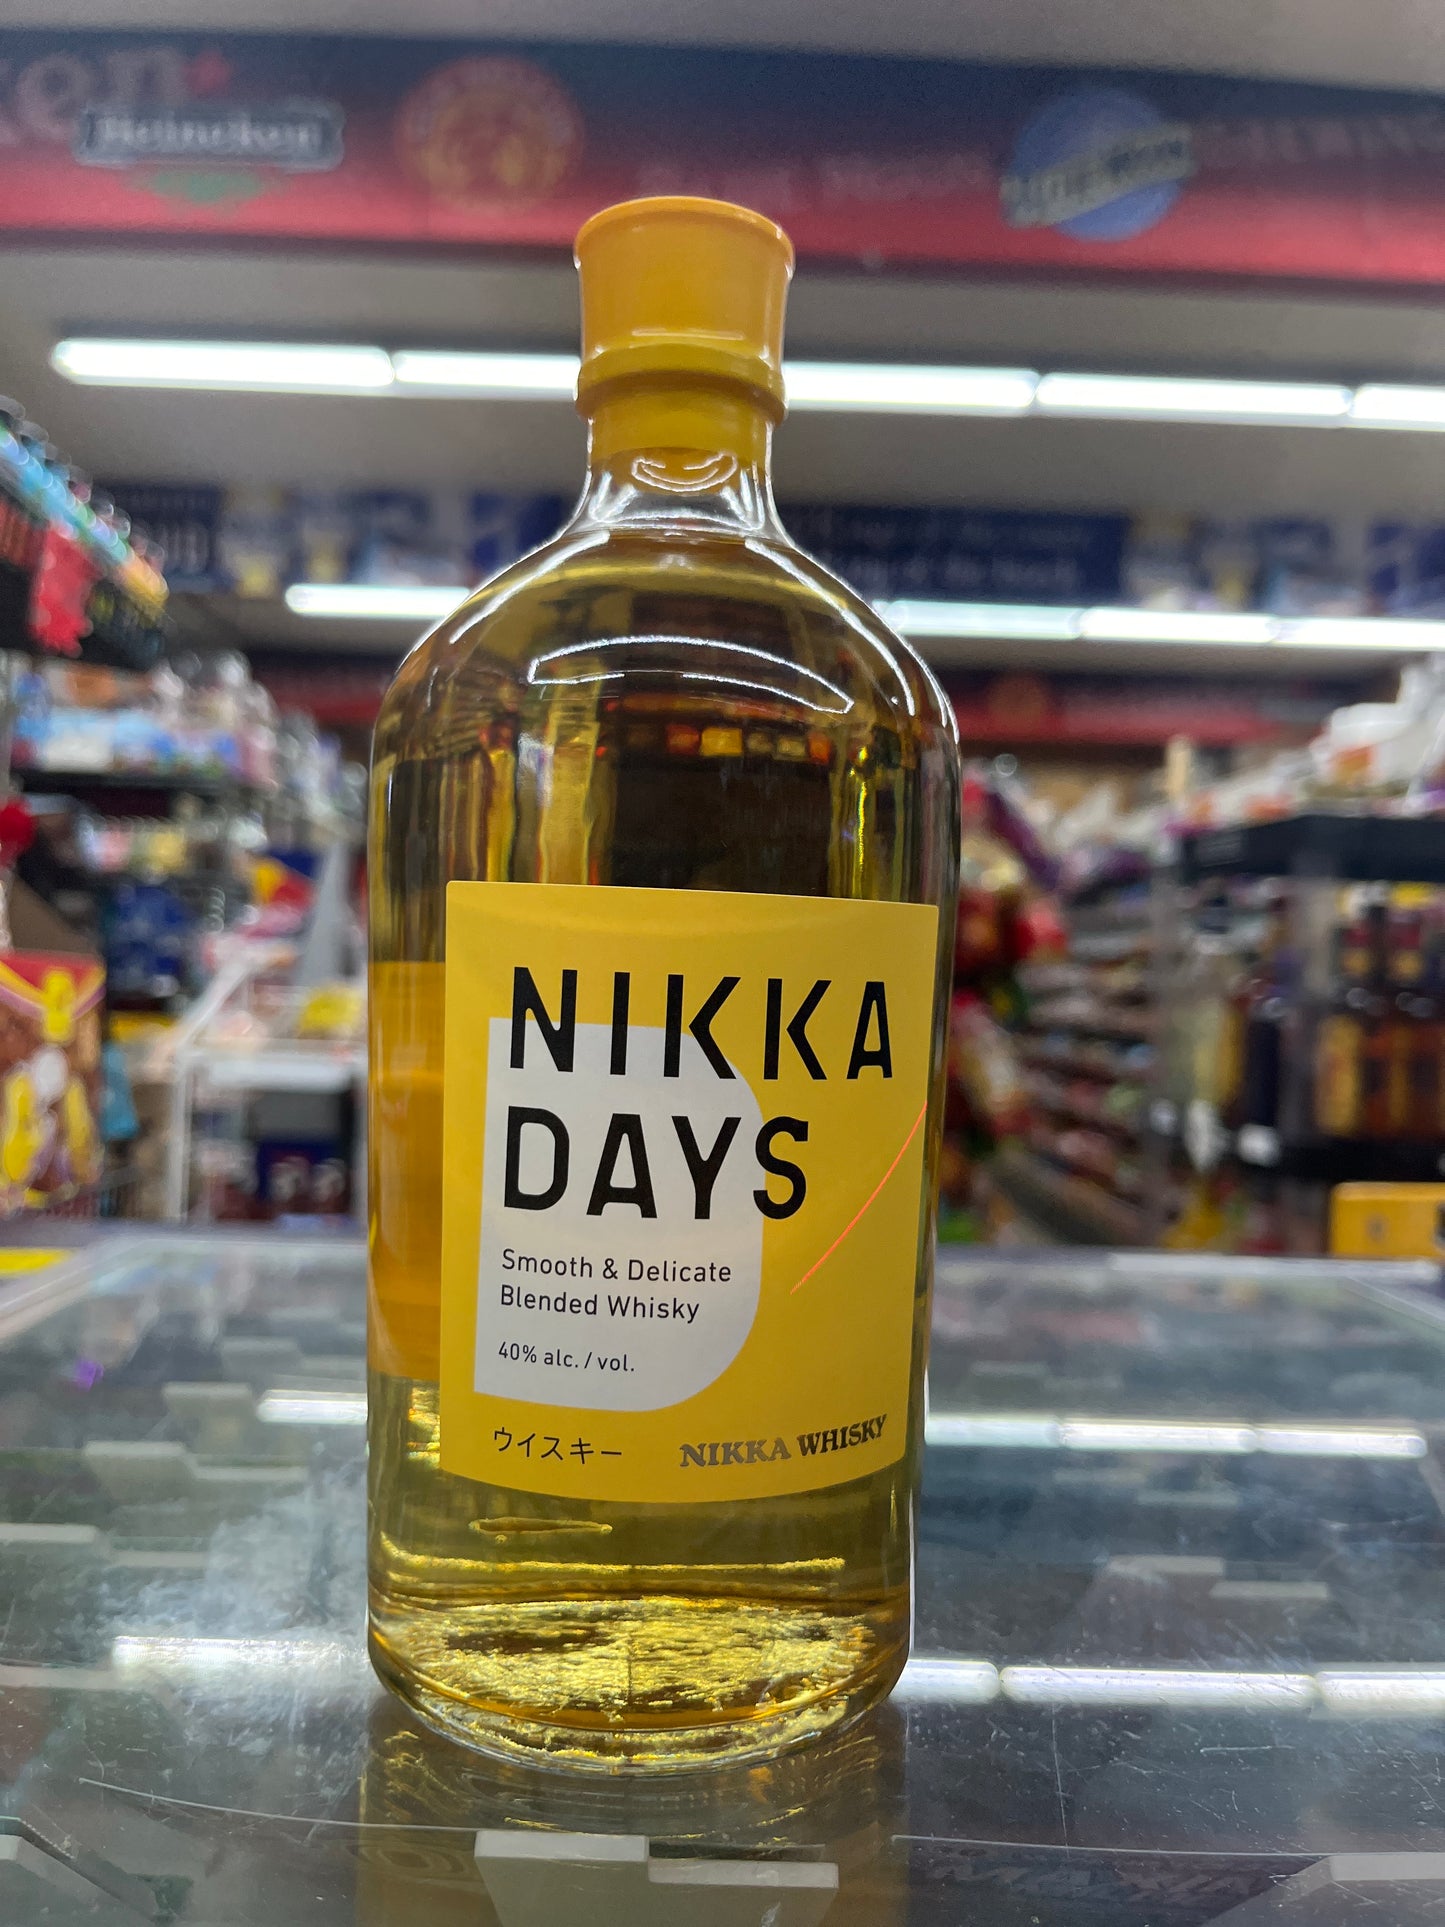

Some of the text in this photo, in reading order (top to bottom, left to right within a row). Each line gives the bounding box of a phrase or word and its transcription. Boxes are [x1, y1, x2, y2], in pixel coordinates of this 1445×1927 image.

[510, 966, 893, 1081] NIKKA
[503, 1105, 809, 1220] DAYS
[501, 1248, 732, 1283] Smooth & Delicate
[500, 1285, 700, 1324] Blended Whisky
[498, 1341, 537, 1364] 40%
[493, 1427, 623, 1465] ウイスキー
[679, 1413, 888, 1468] NIKKA WHISKY
